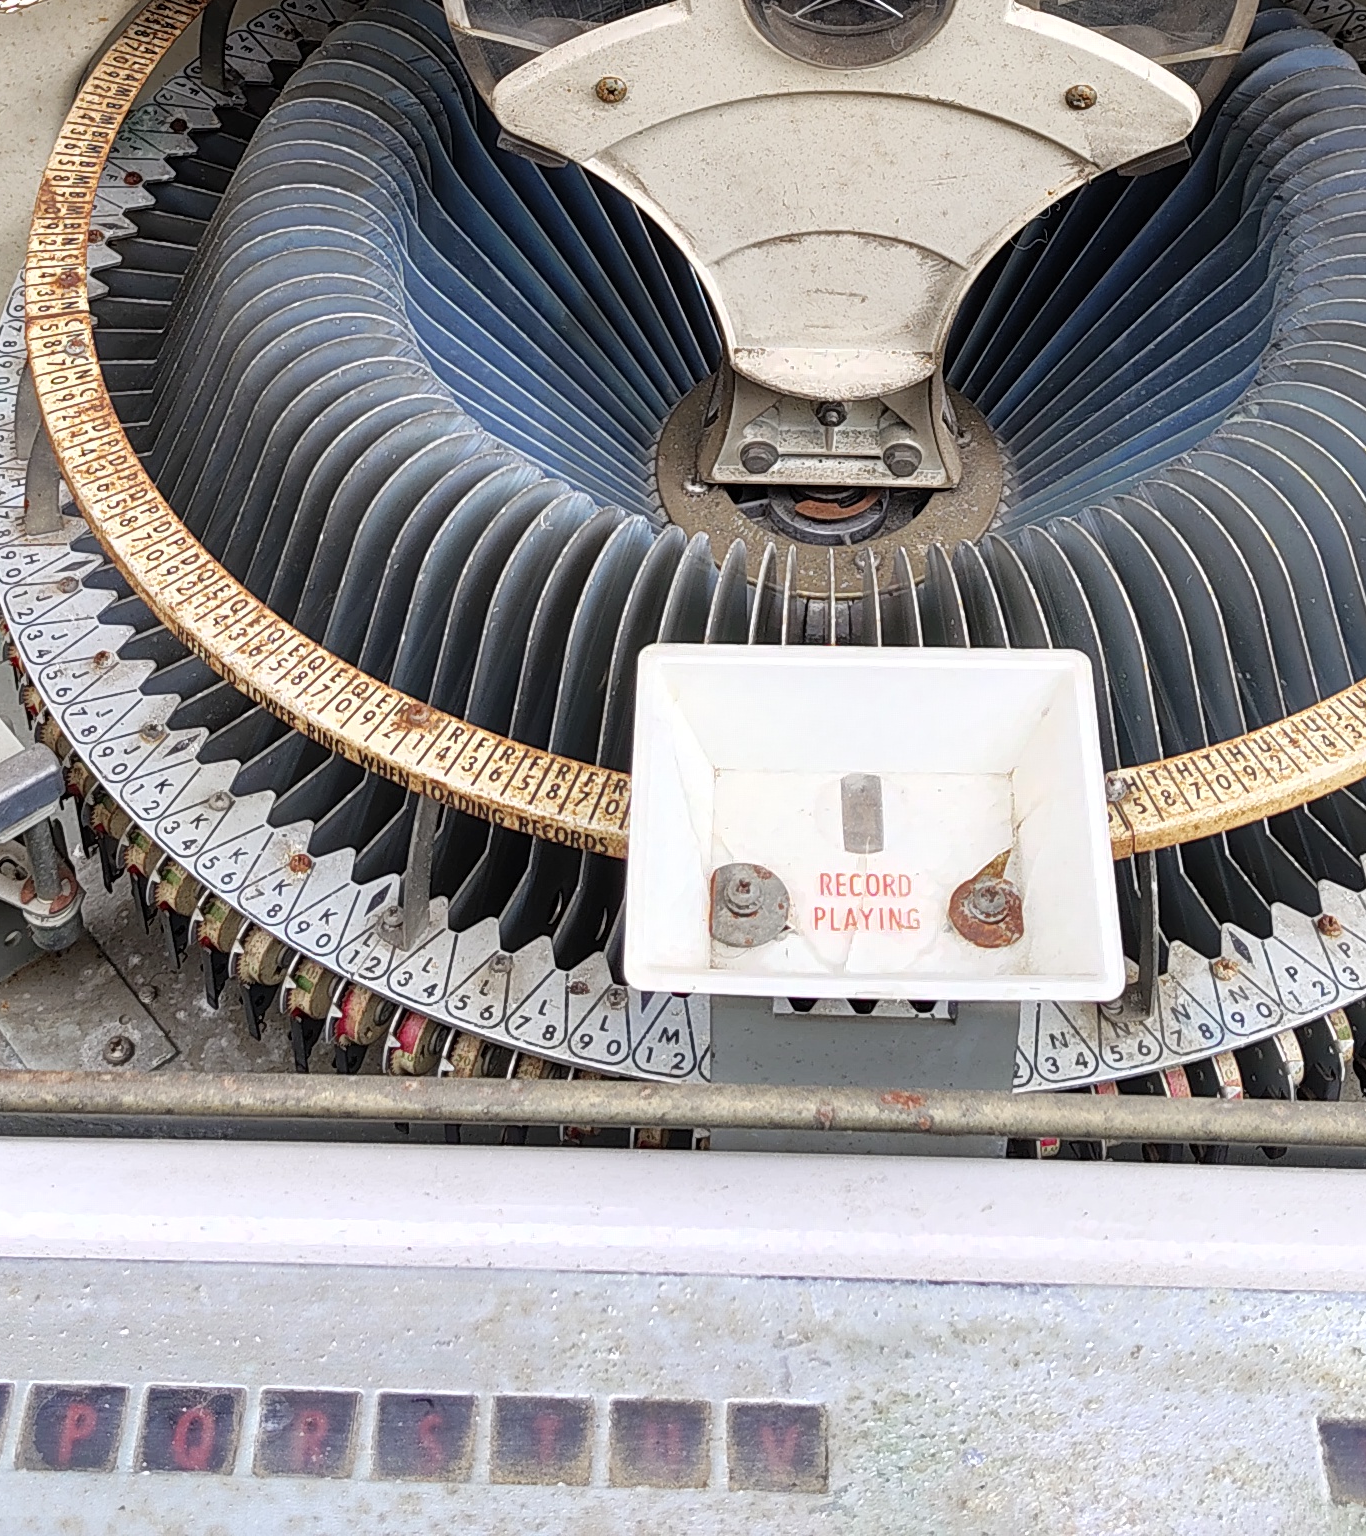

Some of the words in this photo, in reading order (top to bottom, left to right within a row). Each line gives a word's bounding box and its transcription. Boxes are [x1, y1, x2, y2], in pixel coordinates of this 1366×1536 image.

[177, 624, 212, 664] REFER
[221, 664, 237, 685] TO
[246, 680, 296, 726] LOWER
[308, 722, 346, 756] RING
[357, 749, 410, 788] WHEN
[422, 780, 505, 825] LOADING
[519, 817, 609, 853] RECORDS
[819, 872, 912, 897] RECORD
[813, 906, 921, 932] PLAYING
[58, 1404, 95, 1467] P
[173, 1408, 211, 1471] Q
